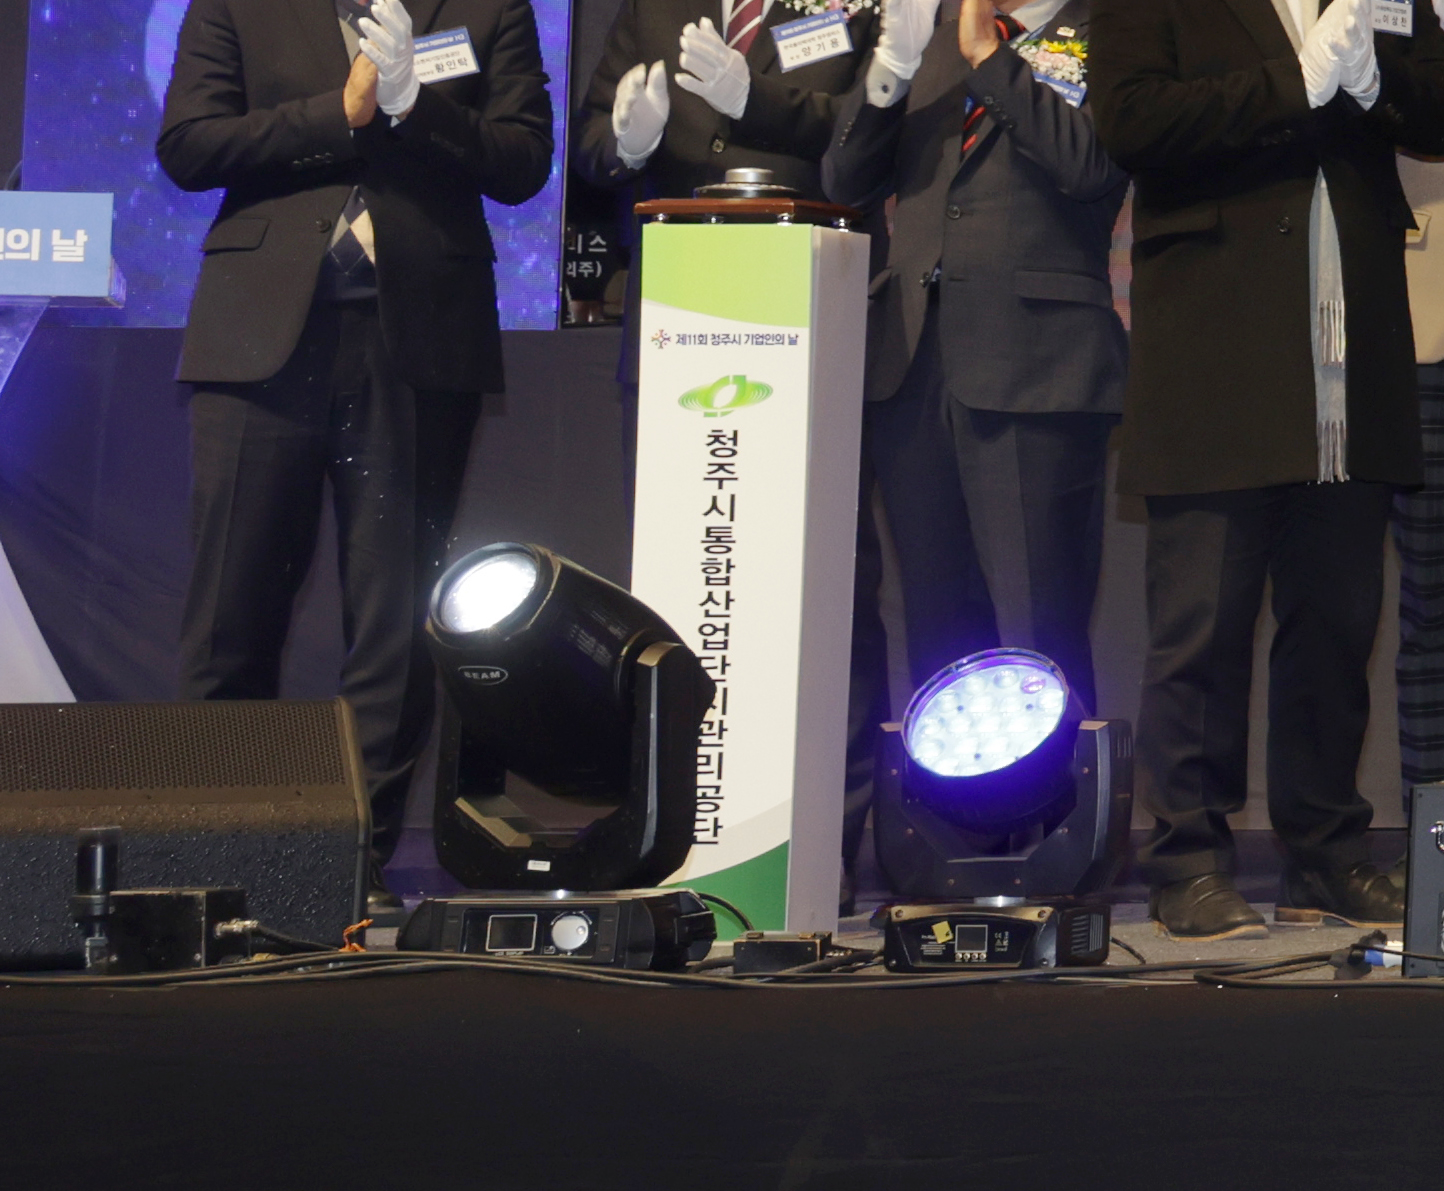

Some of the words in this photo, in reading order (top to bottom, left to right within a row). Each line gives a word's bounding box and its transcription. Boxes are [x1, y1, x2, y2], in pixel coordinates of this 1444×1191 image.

[801, 38, 839, 57] 양기용
[435, 57, 468, 73] 황인탁
[0, 227, 41, 262] 의
[52, 229, 88, 262] 날
[675, 333, 708, 346] 제11회
[710, 333, 742, 346] 청주시
[744, 333, 785, 346] 기업인의
[787, 333, 799, 346] 날
